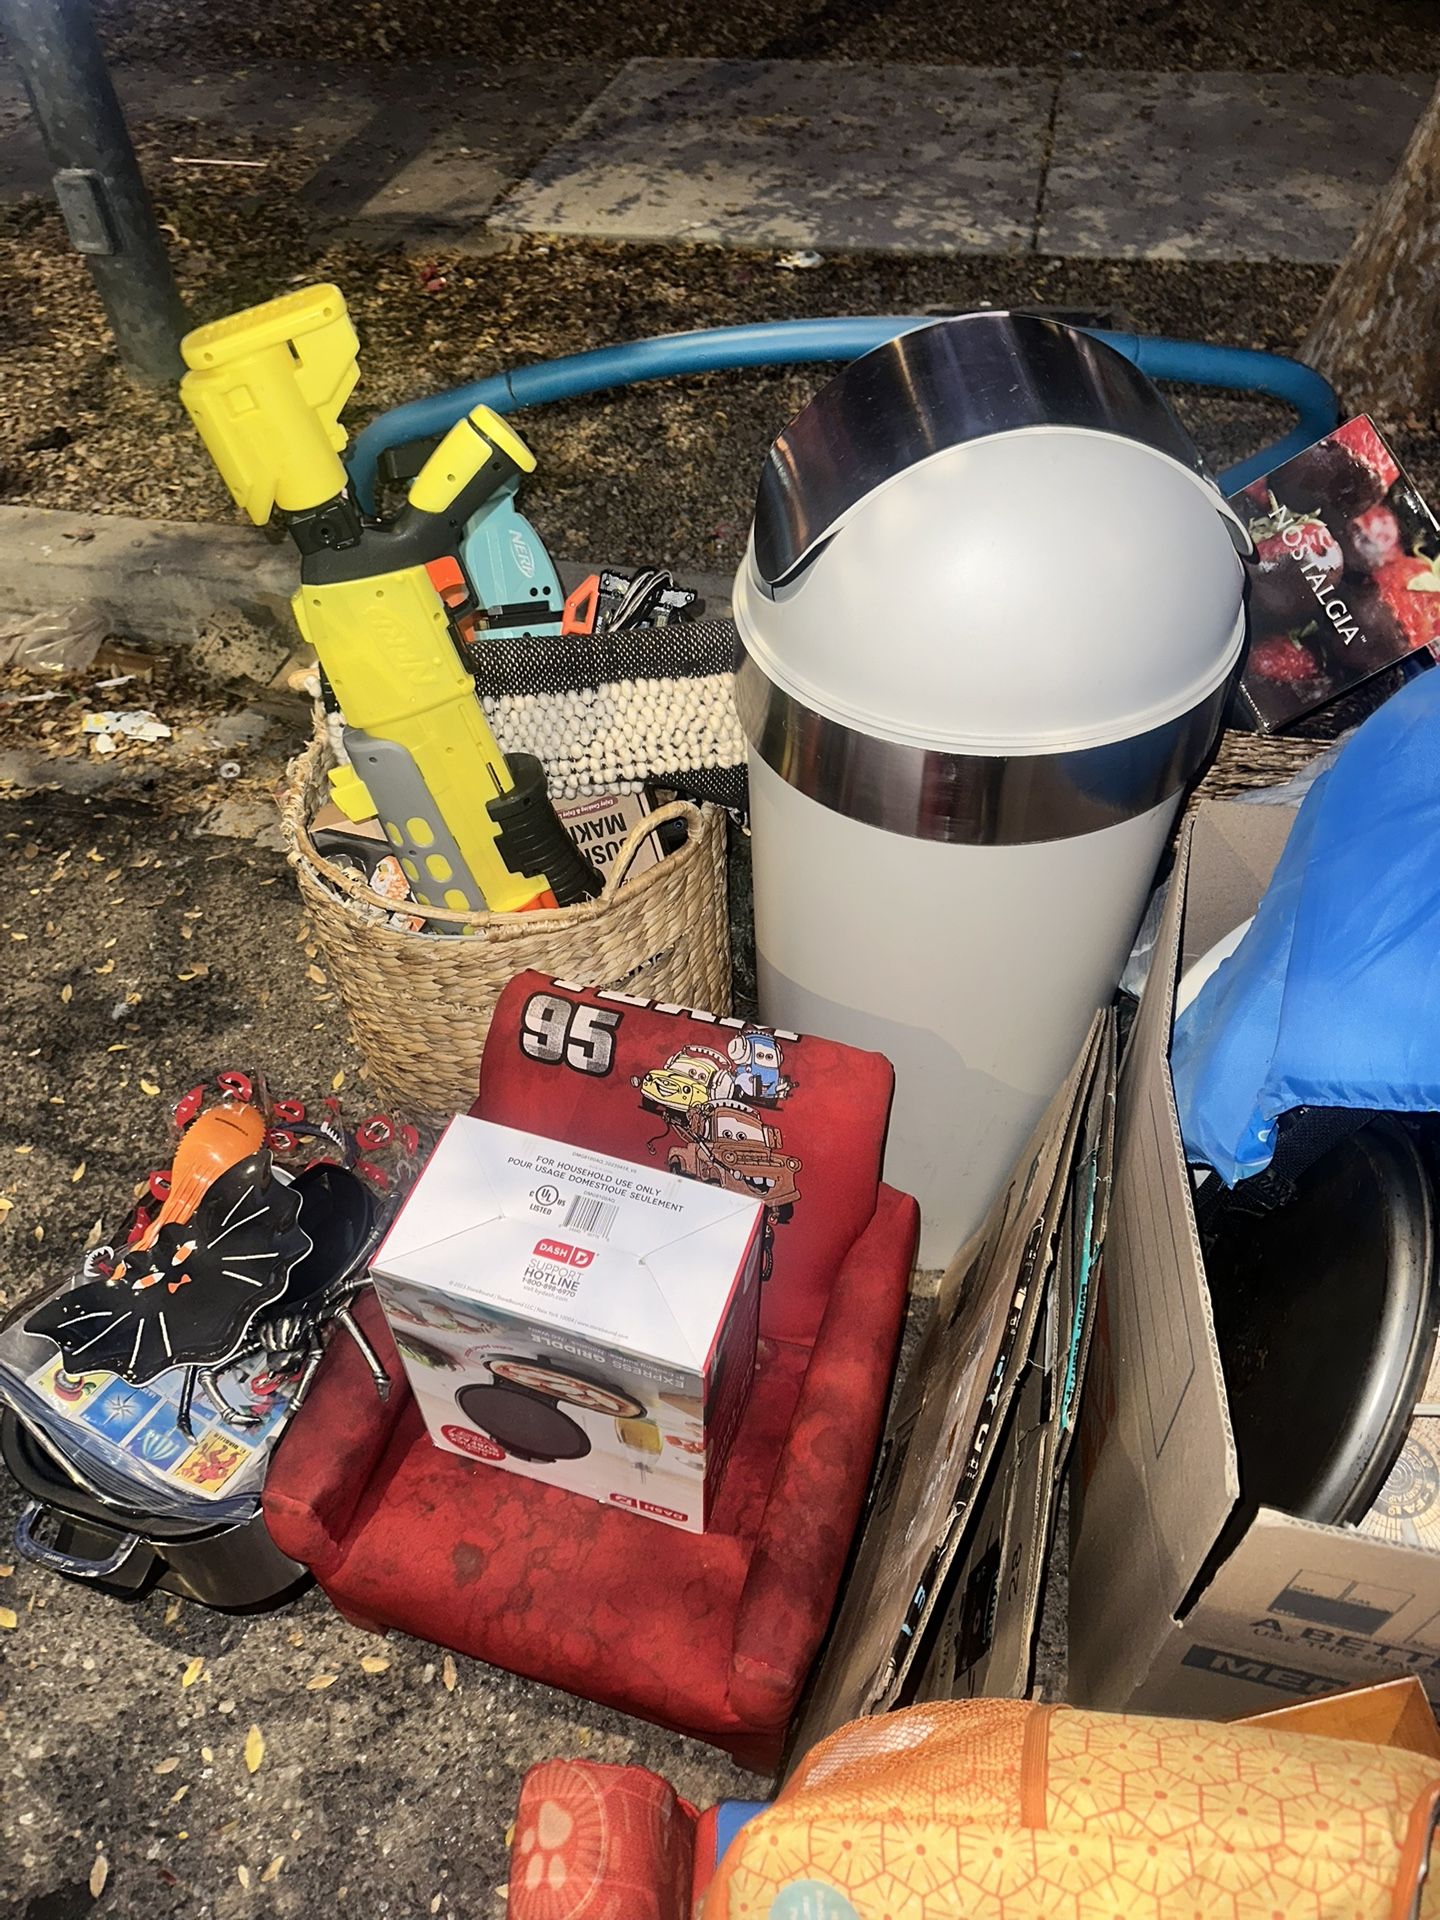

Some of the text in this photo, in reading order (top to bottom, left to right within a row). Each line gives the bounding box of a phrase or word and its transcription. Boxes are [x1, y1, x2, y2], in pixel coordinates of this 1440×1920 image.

[508, 529, 535, 579] NERF
[581, 803, 600, 812] Cooking
[520, 991, 624, 1077] 95
[507, 1156, 684, 1213] POUR USAGE DOMESTIQUE SEULEMENT
[536, 1155, 555, 1167] FOR
[557, 1161, 613, 1183] HOUSEHOLD
[615, 1177, 634, 1189] USE
[636, 1184, 662, 1196] ONLY
[529, 1203, 553, 1216] LISTED
[539, 1243, 568, 1258] DASH
[524, 1267, 580, 1292] HOTLINE
[528, 1258, 585, 1281] SUPPORT
[522, 1276, 576, 1298] 1-800-898-6970
[530, 1333, 606, 1363] GRIDDLE
[612, 1360, 685, 1389] EXPRESS
[644, 1504, 683, 1520] DASH
[1250, 1617, 1283, 1633] A
